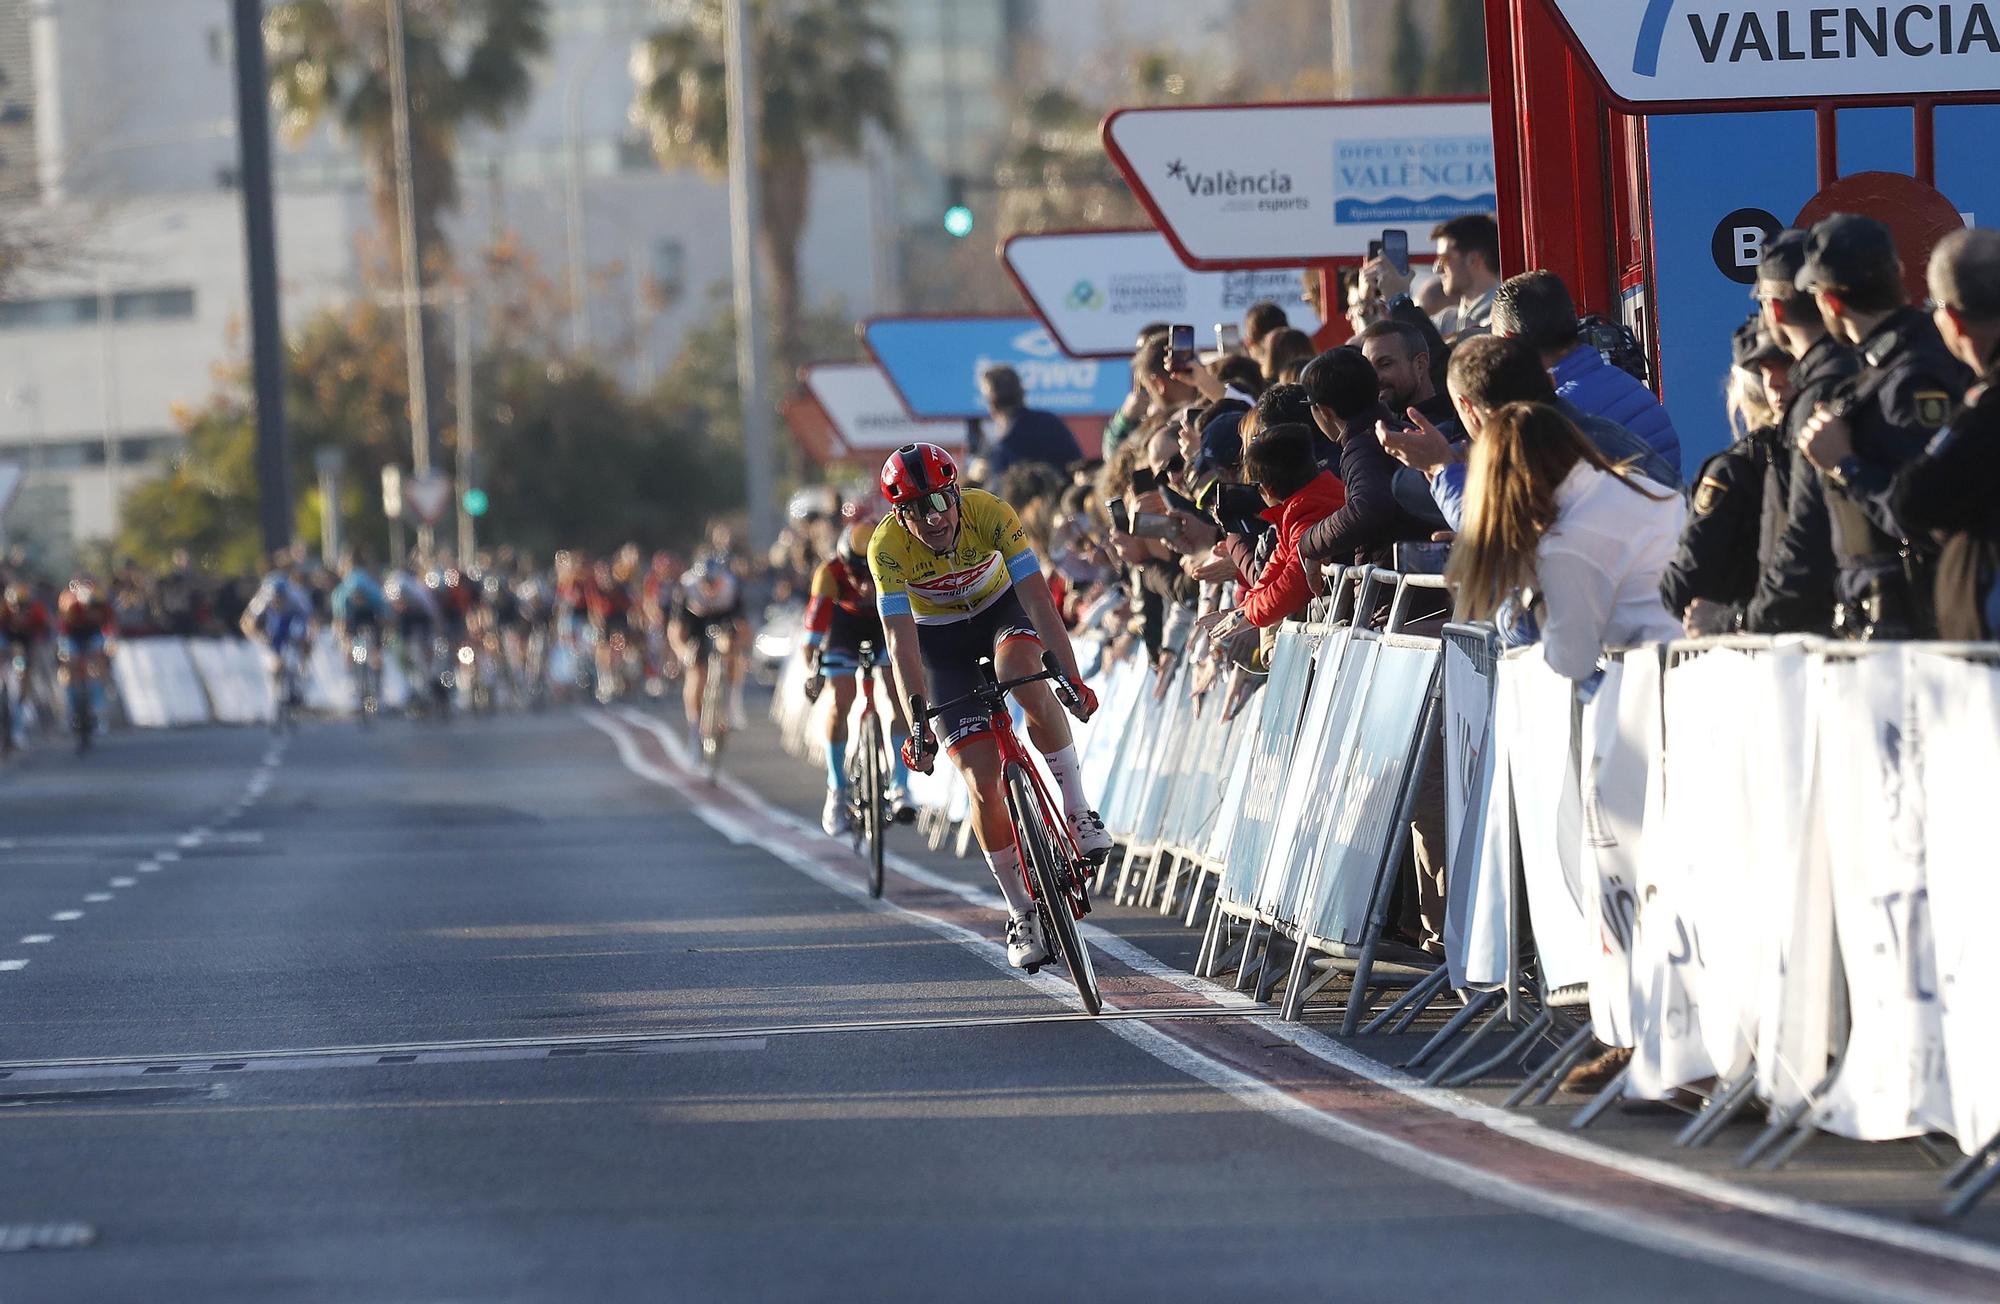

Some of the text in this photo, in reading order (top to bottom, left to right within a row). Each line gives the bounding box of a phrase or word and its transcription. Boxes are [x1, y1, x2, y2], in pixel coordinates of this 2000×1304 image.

[1687, 4, 2000, 63] VALENCIA
[1184, 169, 1292, 196] València
[1057, 674, 1079, 702] SRAM
